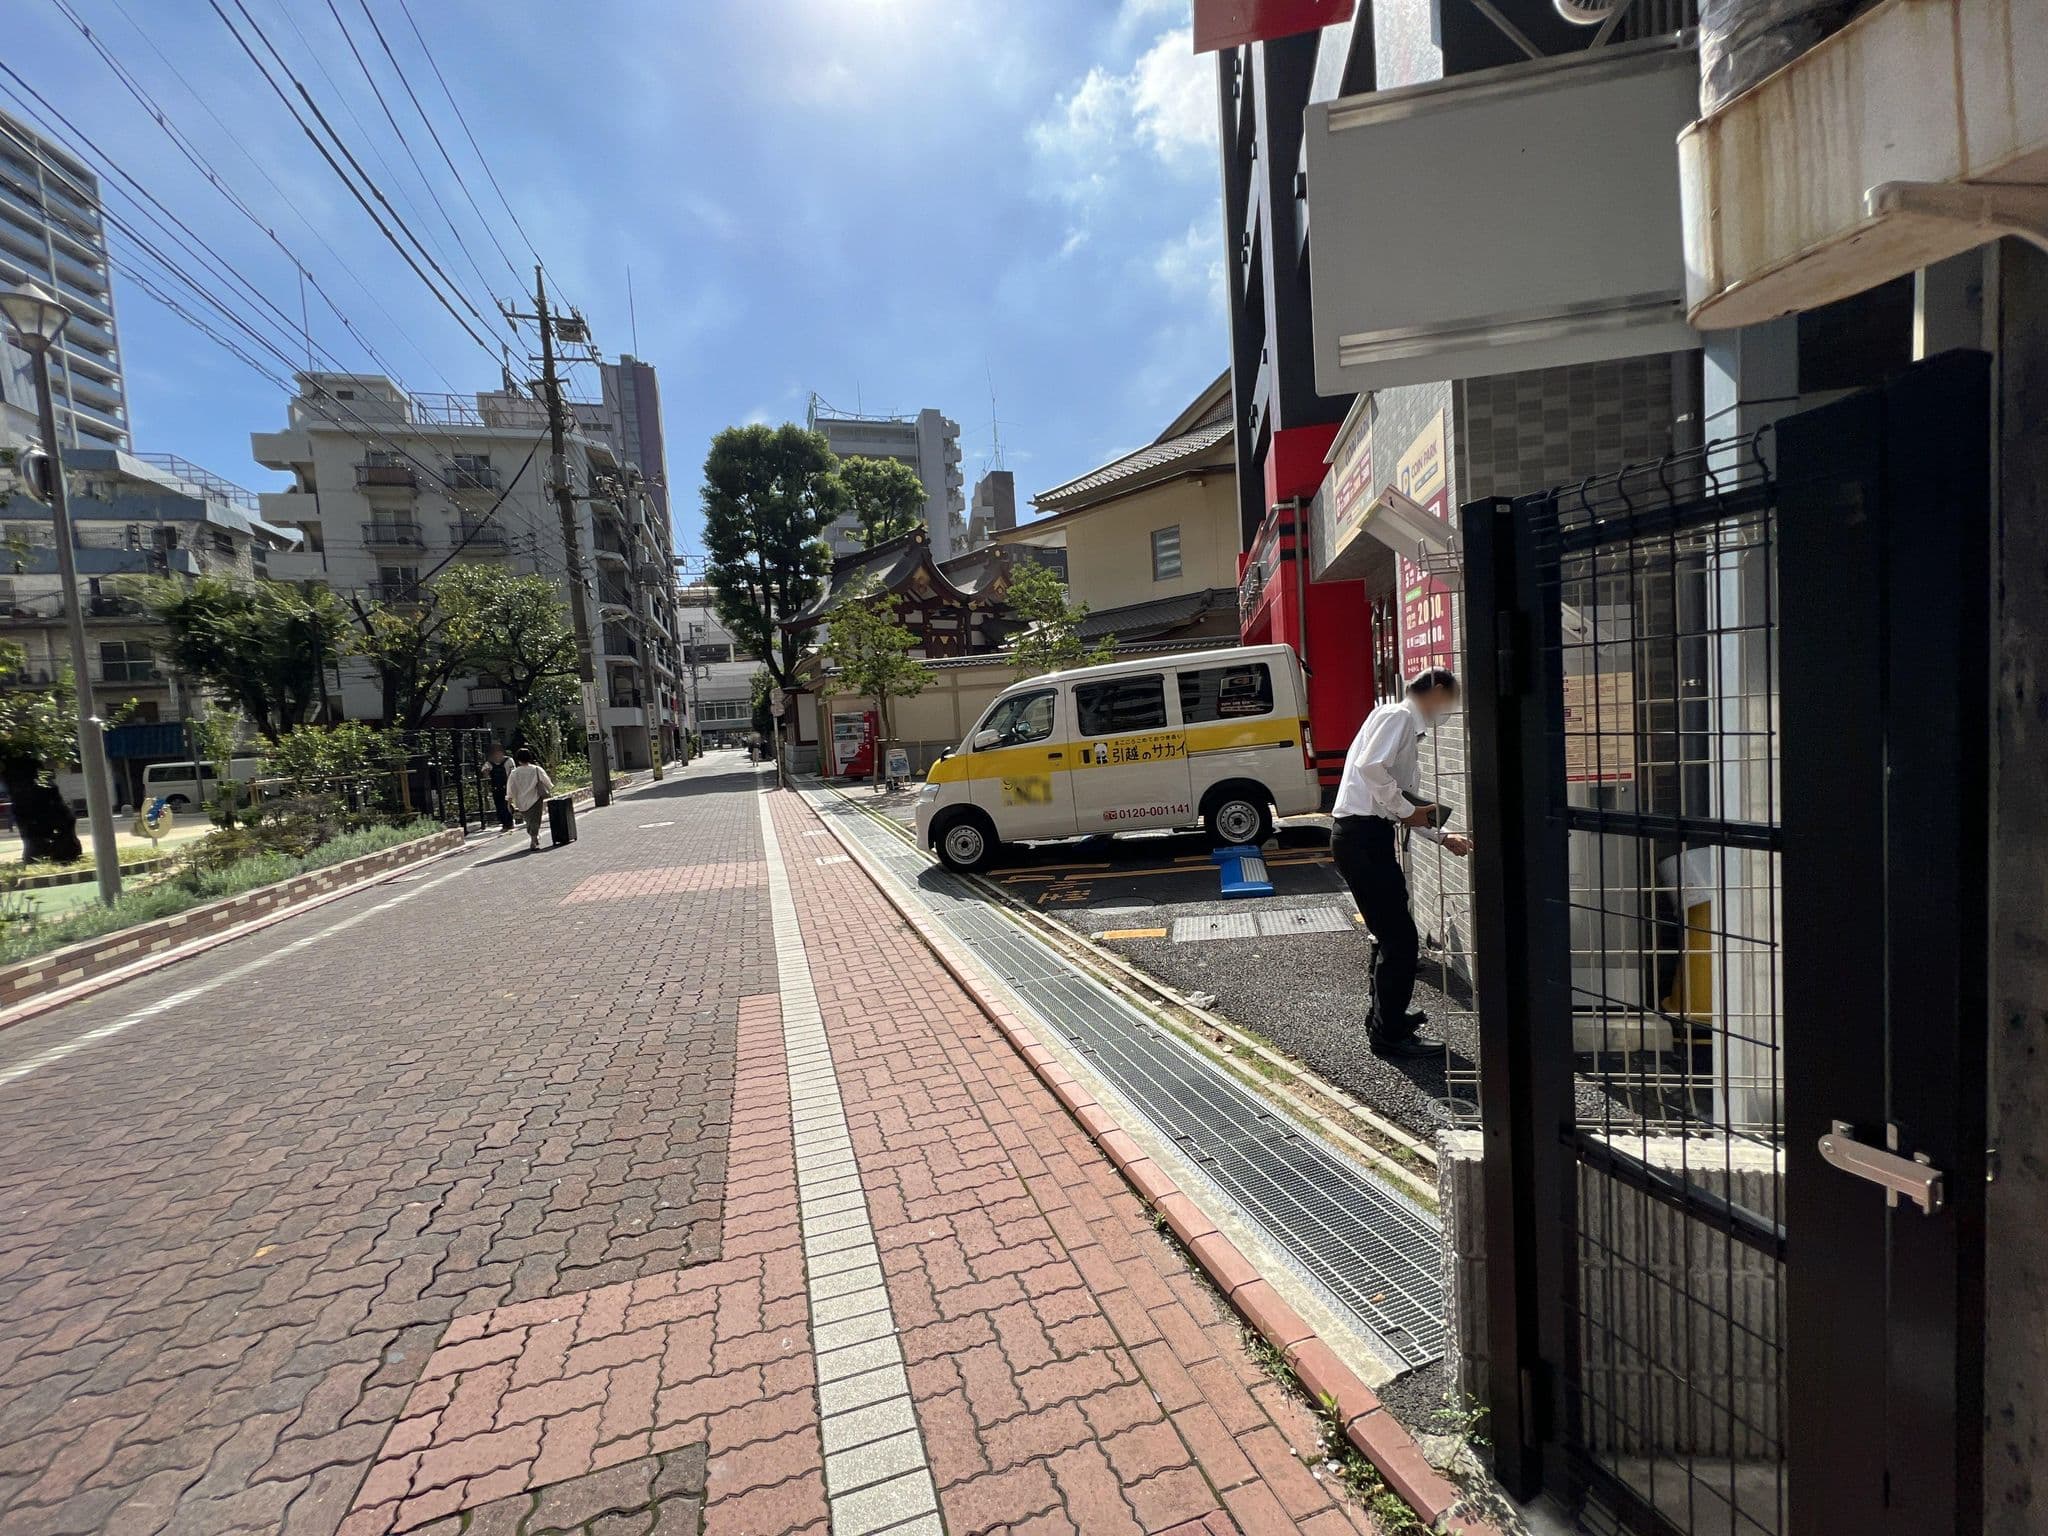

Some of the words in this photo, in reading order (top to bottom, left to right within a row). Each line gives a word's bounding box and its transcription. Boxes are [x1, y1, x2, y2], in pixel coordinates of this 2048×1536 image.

[1411, 456, 1423, 478] COIN
[1423, 440, 1437, 467] PARK
[1112, 741, 1185, 763] 引越のサカイ
[1119, 803, 1190, 819] 0120-001141
